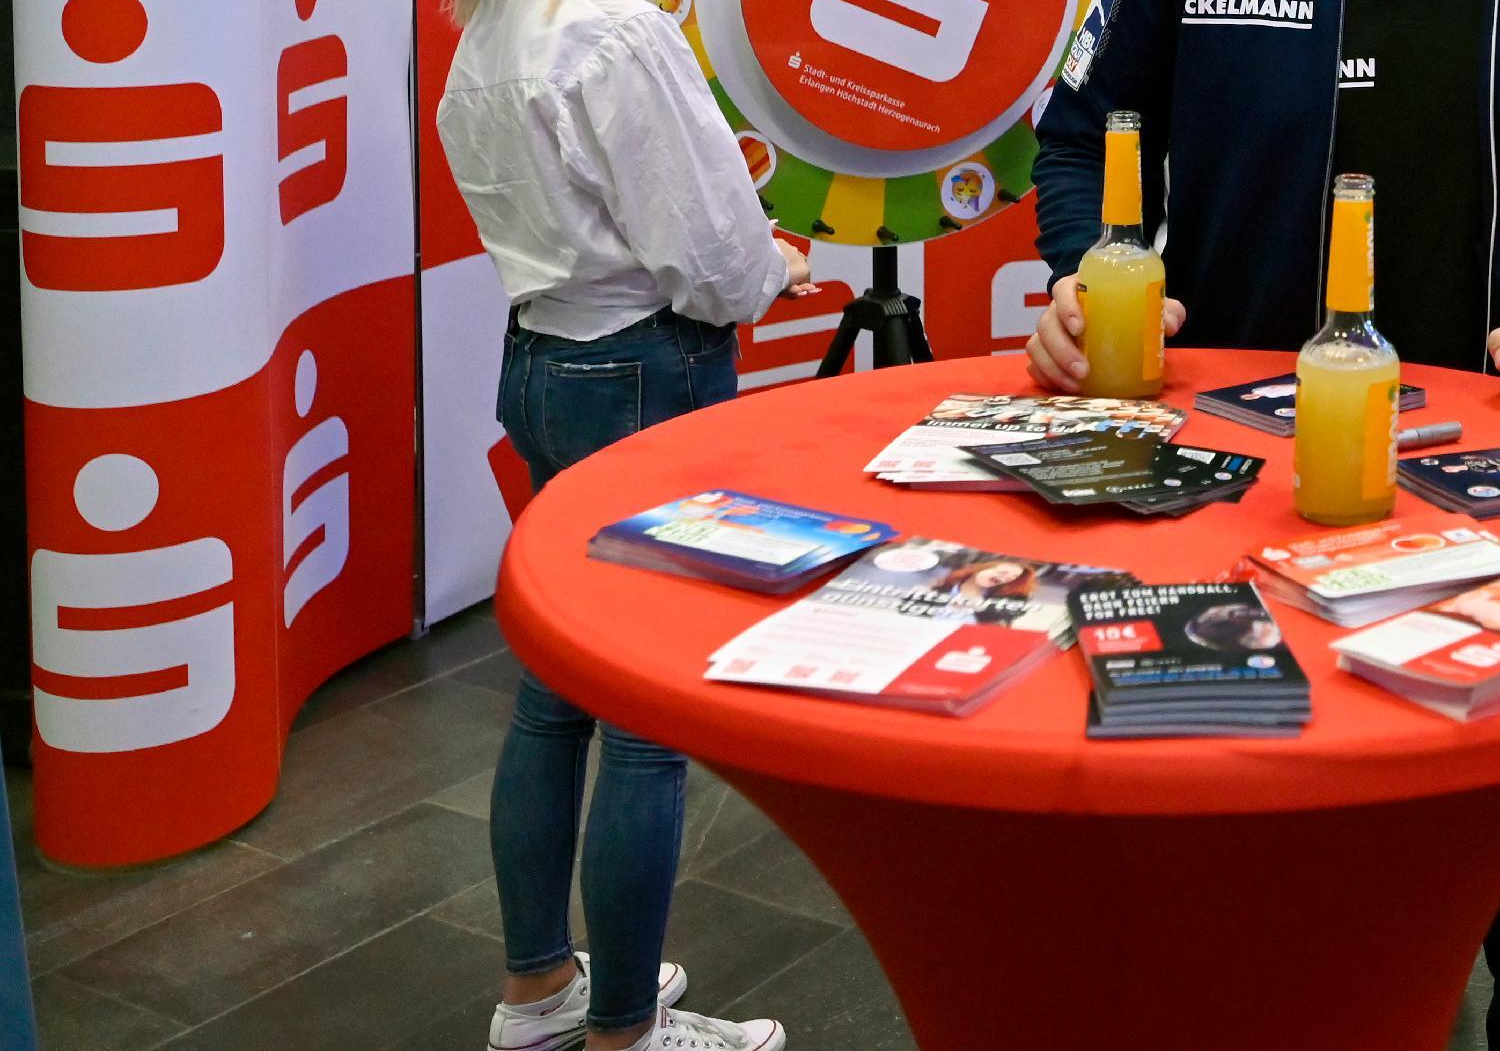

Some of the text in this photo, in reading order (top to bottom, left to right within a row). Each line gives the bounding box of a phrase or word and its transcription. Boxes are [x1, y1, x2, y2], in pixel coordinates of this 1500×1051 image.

[799, 75, 941, 134] Erlangen Höchstadt Herzogenaurach
[804, 64, 906, 109] Stadt- und Kreissparkasse
